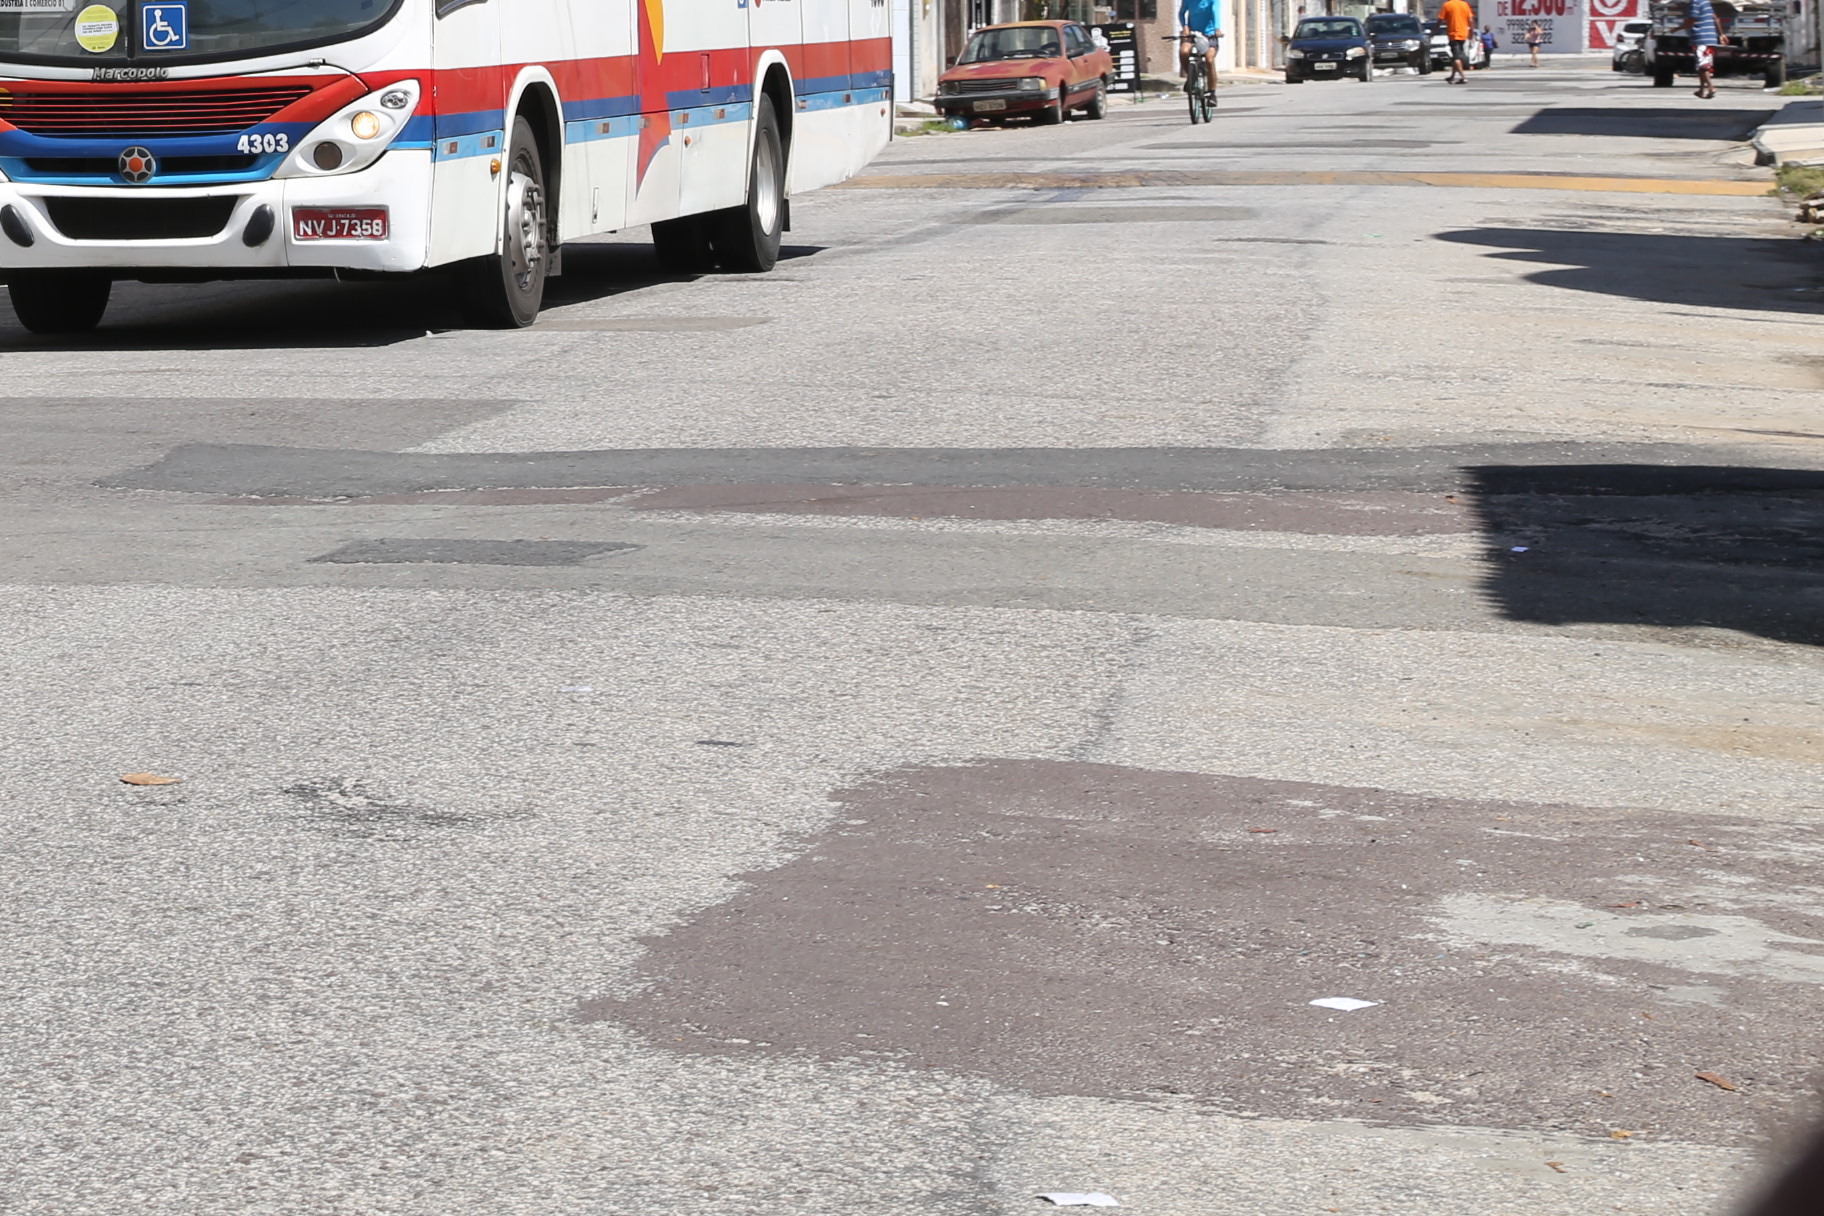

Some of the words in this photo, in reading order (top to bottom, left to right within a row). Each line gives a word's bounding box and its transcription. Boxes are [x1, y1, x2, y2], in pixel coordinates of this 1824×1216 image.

[1497, 1, 1509, 16] DE
[93, 67, 169, 80] Marcopolo
[237, 133, 289, 154] 4303
